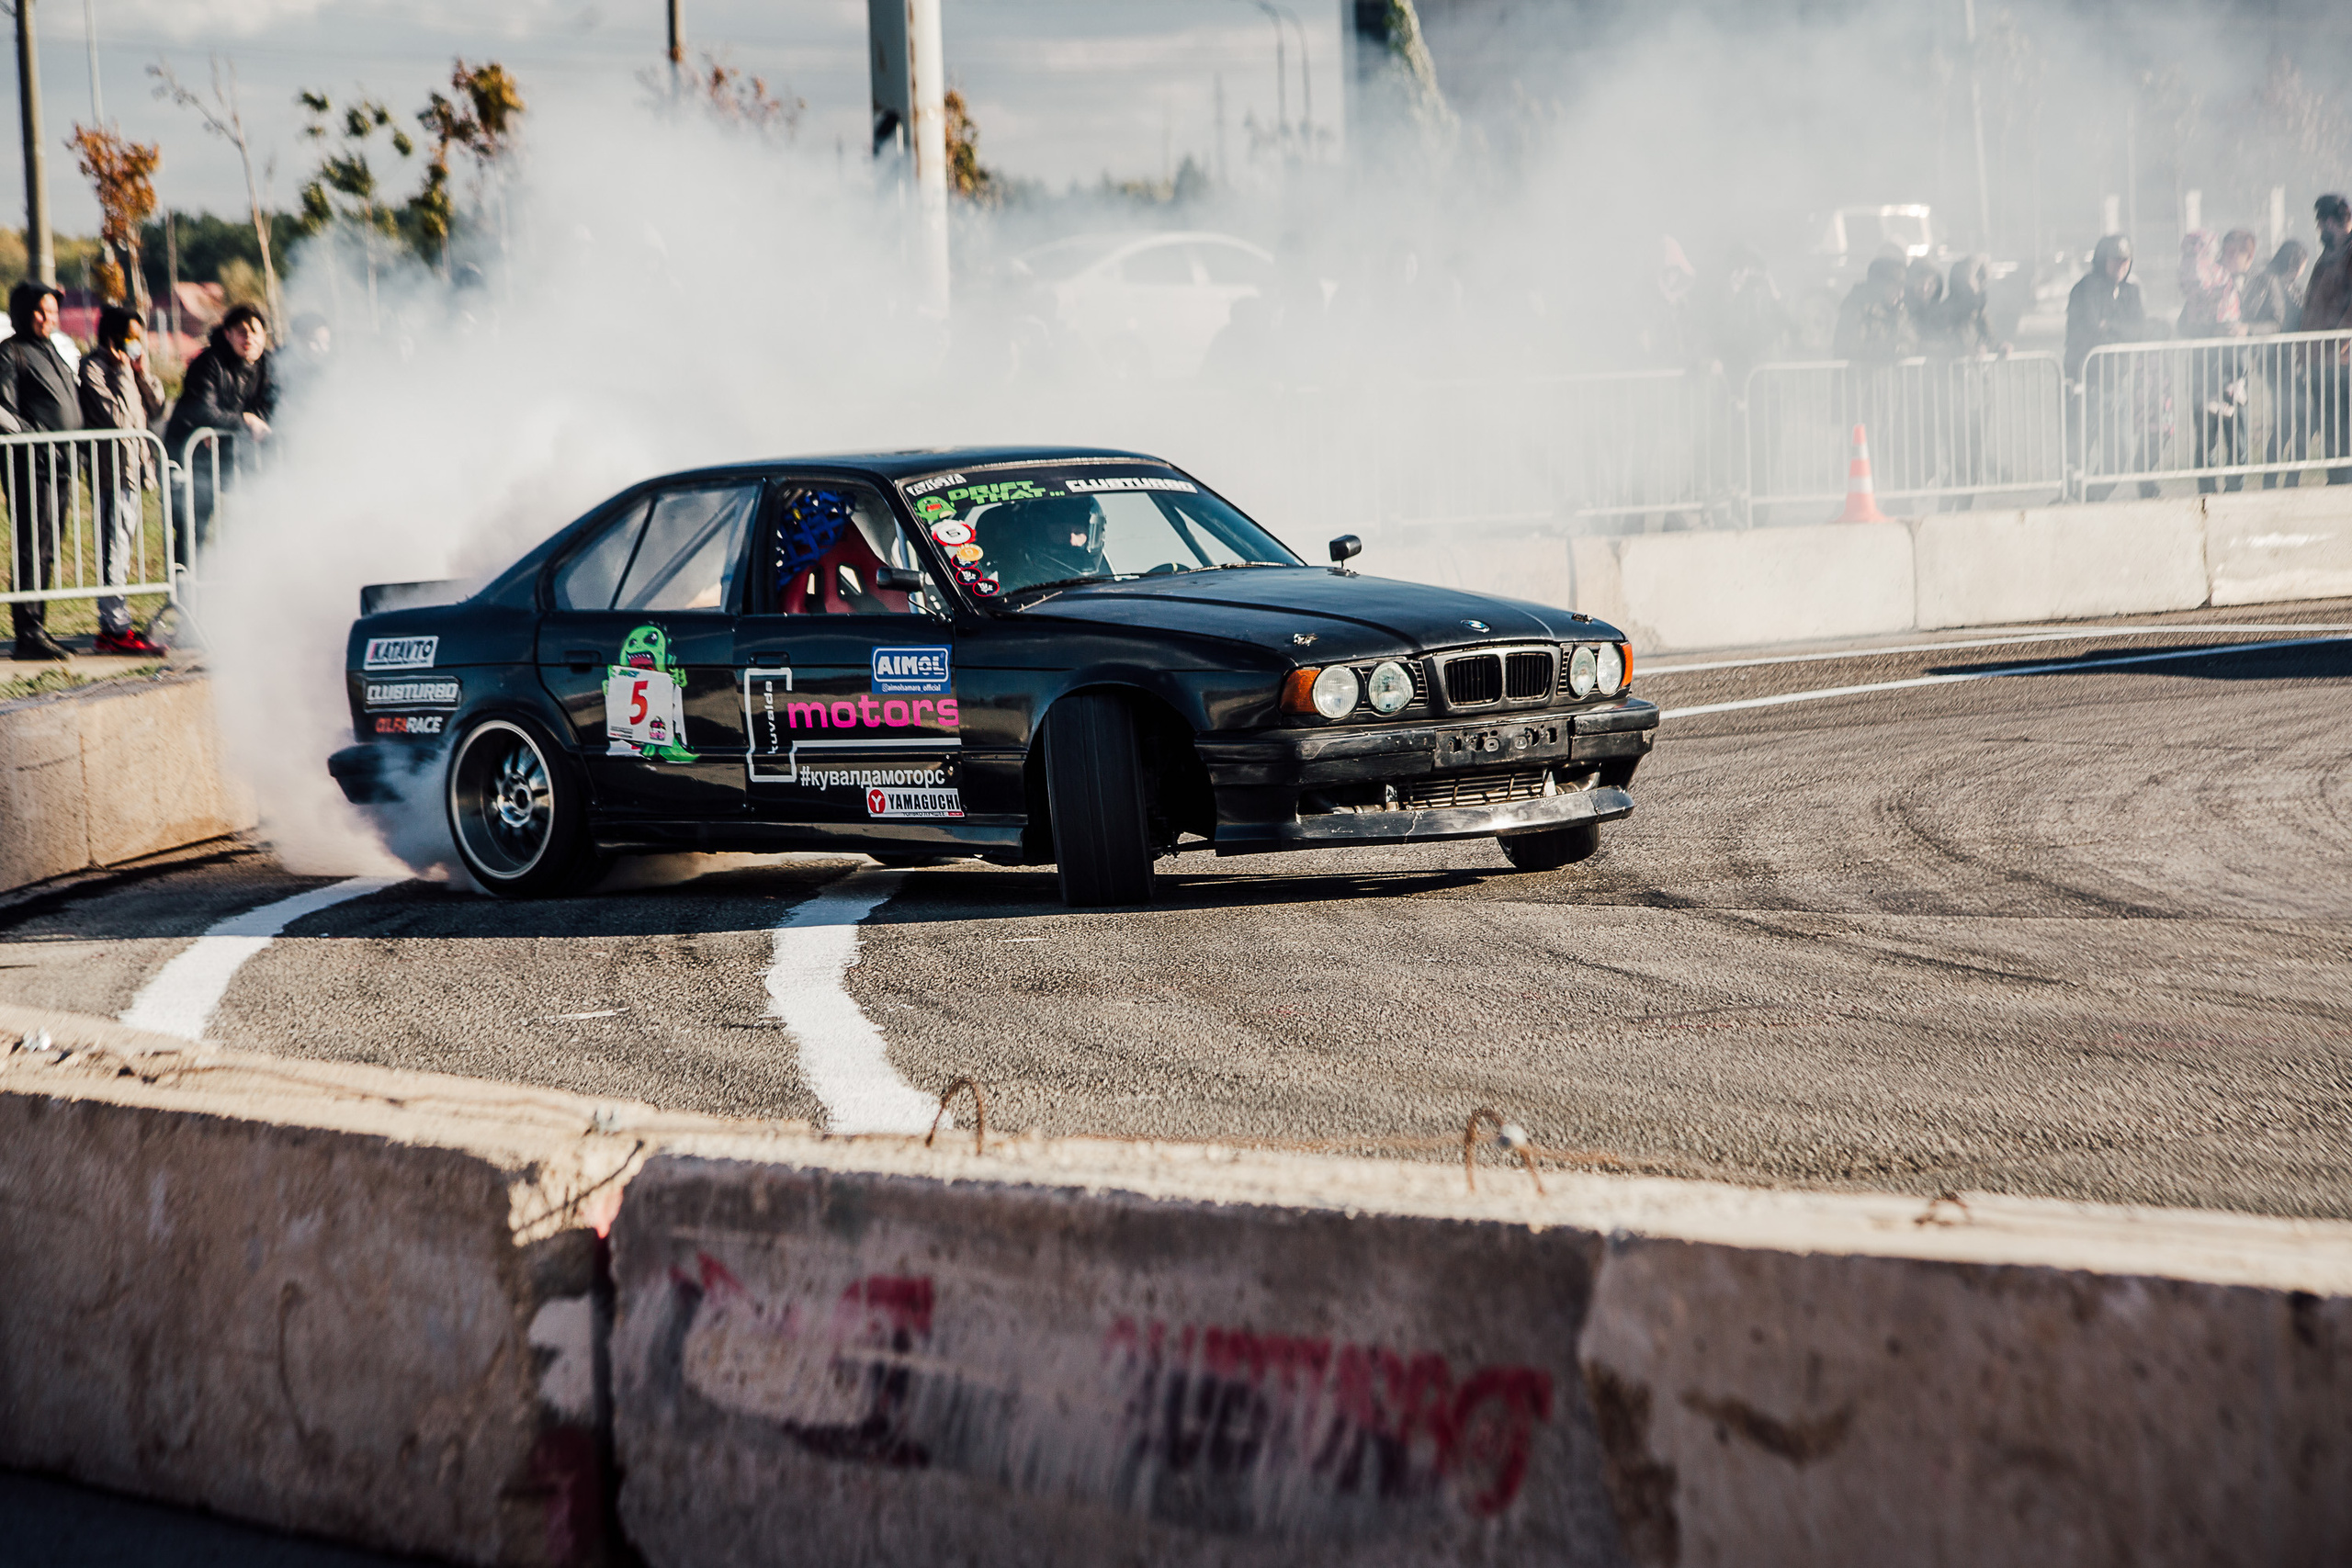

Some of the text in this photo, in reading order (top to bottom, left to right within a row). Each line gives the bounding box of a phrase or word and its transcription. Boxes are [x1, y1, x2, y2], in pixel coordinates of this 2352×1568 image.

[947, 480, 1035, 502] DRIFT
[1065, 477, 1198, 493] CLUBTURBO
[877, 656, 944, 675] AIMOL
[367, 682, 459, 701] CLUBTURBO
[628, 680, 649, 725] 5
[764, 681, 779, 754] kuvalda
[787, 695, 960, 728] motors
[799, 766, 945, 791] #кувалдамоторс
[888, 795, 959, 810] YAMAGUCHI
